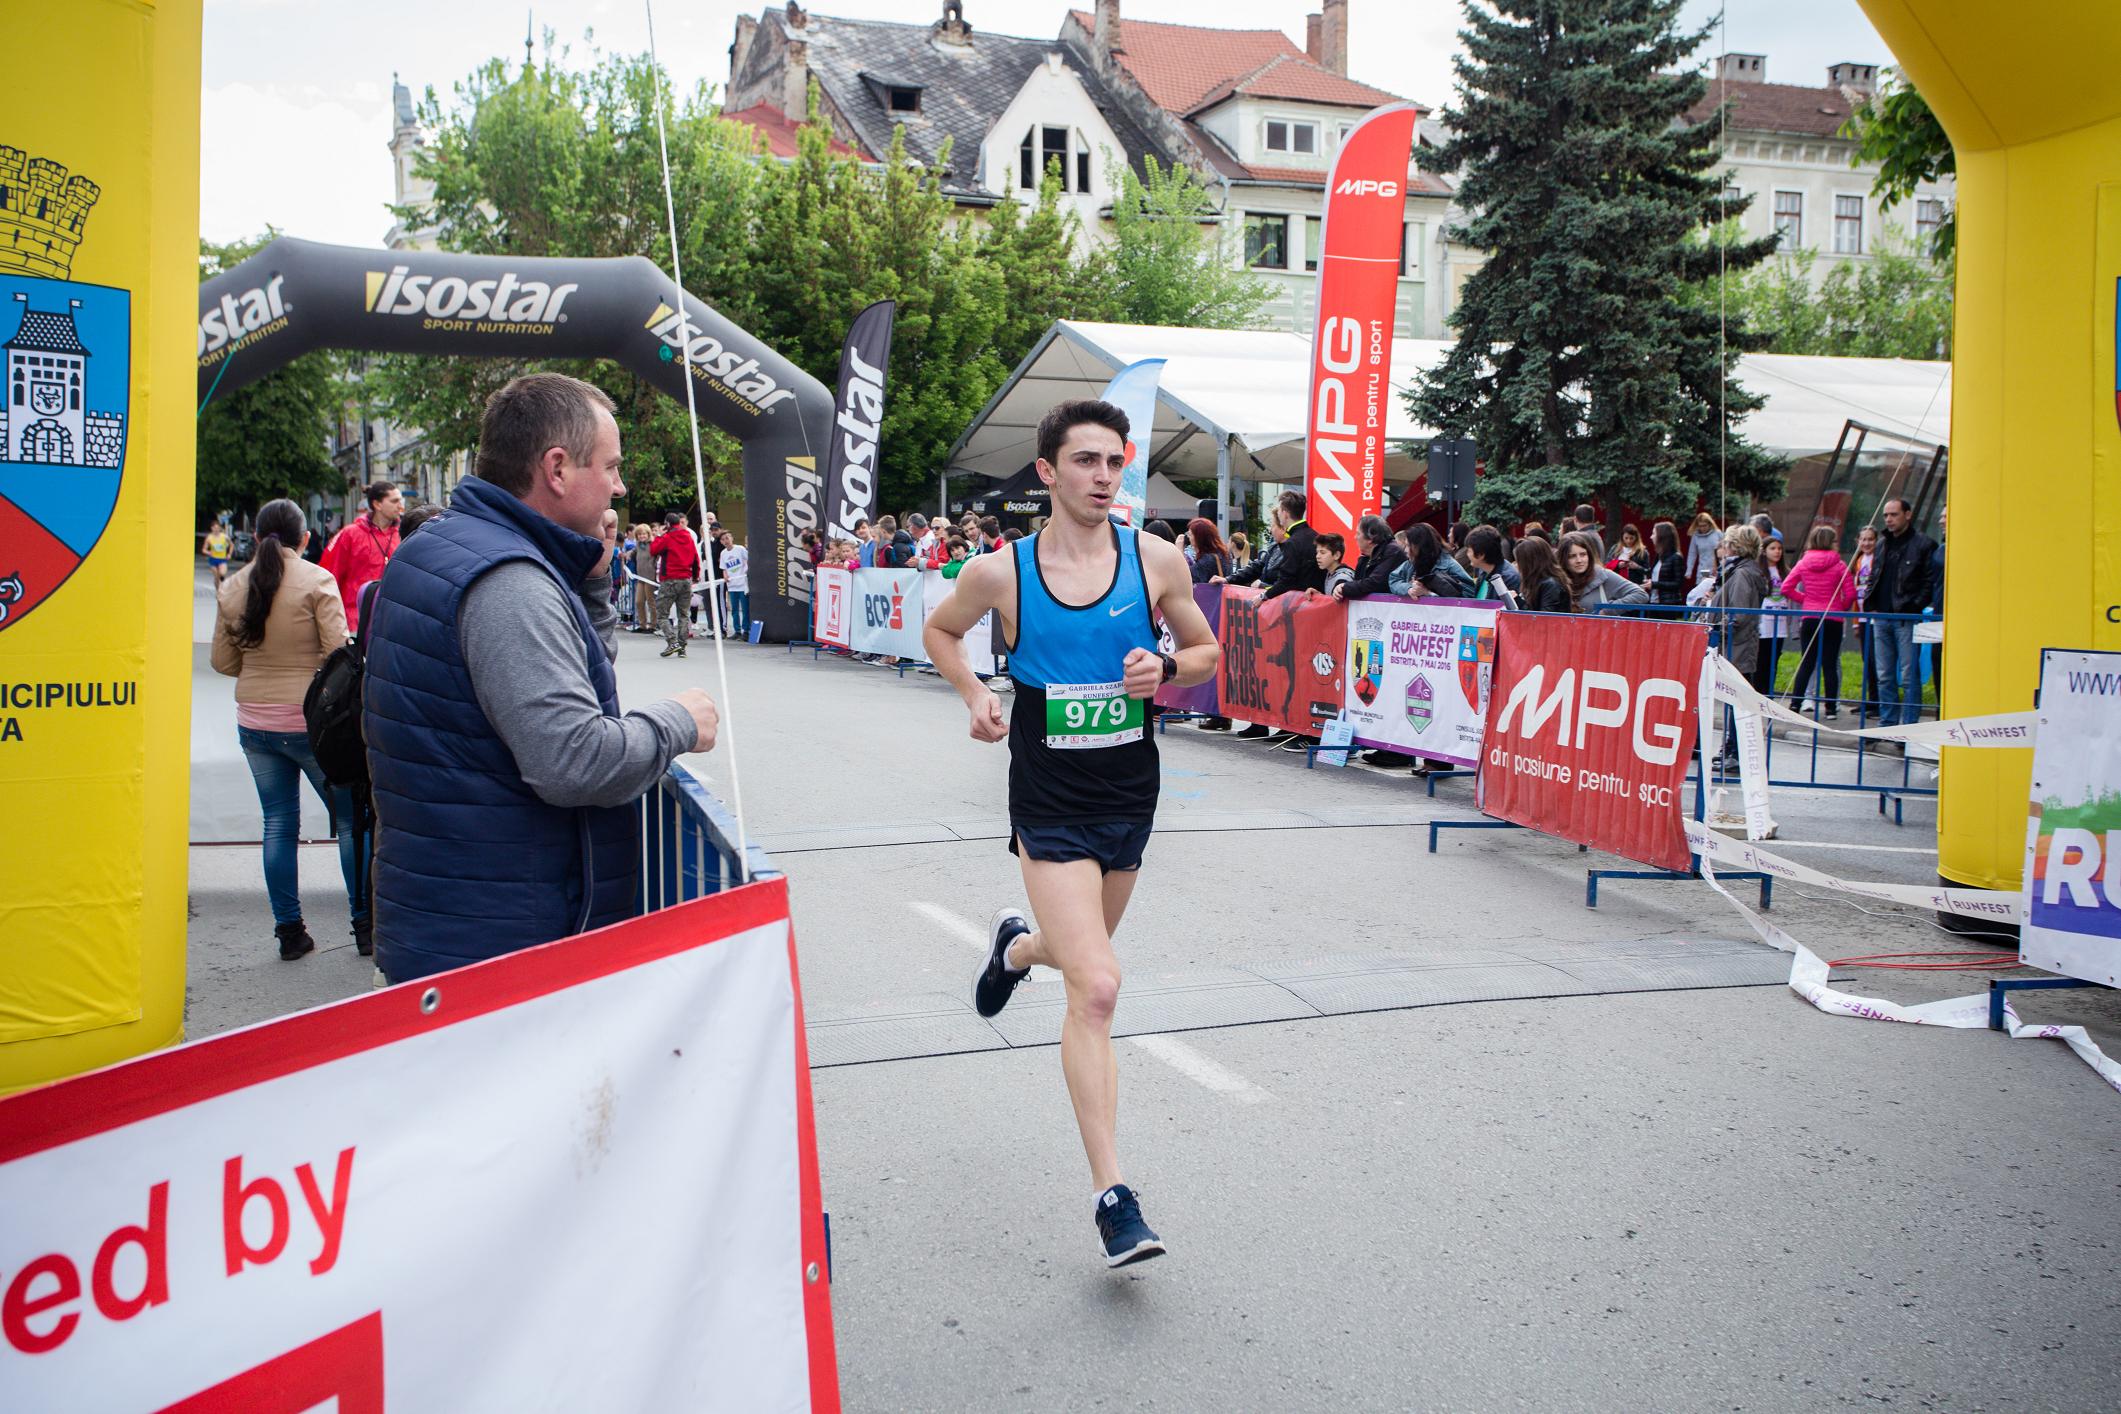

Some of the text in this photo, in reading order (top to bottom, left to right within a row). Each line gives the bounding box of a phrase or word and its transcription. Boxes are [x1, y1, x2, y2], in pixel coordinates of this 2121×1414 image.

[1334, 179, 1398, 198] MPG
[376, 265, 578, 323] isostar
[198, 315, 289, 367] ORT NUTRITION
[423, 318, 554, 335] SPORT NUTRITION
[1370, 319, 1384, 366] sport
[650, 310, 795, 410] isostar
[708, 378, 762, 417] NUTRITION
[1367, 372, 1380, 429] pentru
[1313, 316, 1362, 530] MPG
[828, 346, 884, 545] isostar
[1363, 436, 1376, 501] pasiune
[1006, 501, 1042, 512] isostar
[776, 499, 786, 597] SPORT NUTRITION
[865, 593, 890, 629] BCR
[1225, 598, 1263, 649] FEEL
[1391, 620, 1455, 635] GABRIELA SZABO
[1222, 643, 1257, 678] YOUR
[1391, 632, 1454, 659] RUNFEST
[1425, 660, 1437, 669] MAI
[1069, 684, 1104, 692] GABRIELA
[1226, 672, 1271, 712] MUSIC
[1065, 697, 1127, 728] 979
[1496, 664, 1686, 766] MPG
[1970, 725, 2028, 739] RUNFEST
[1490, 745, 1509, 769] din
[1514, 755, 1572, 784] pasiune
[1578, 767, 1631, 798] pentru
[1952, 899, 2012, 915] RUNFEST
[0, 1145, 356, 1355] ed by
